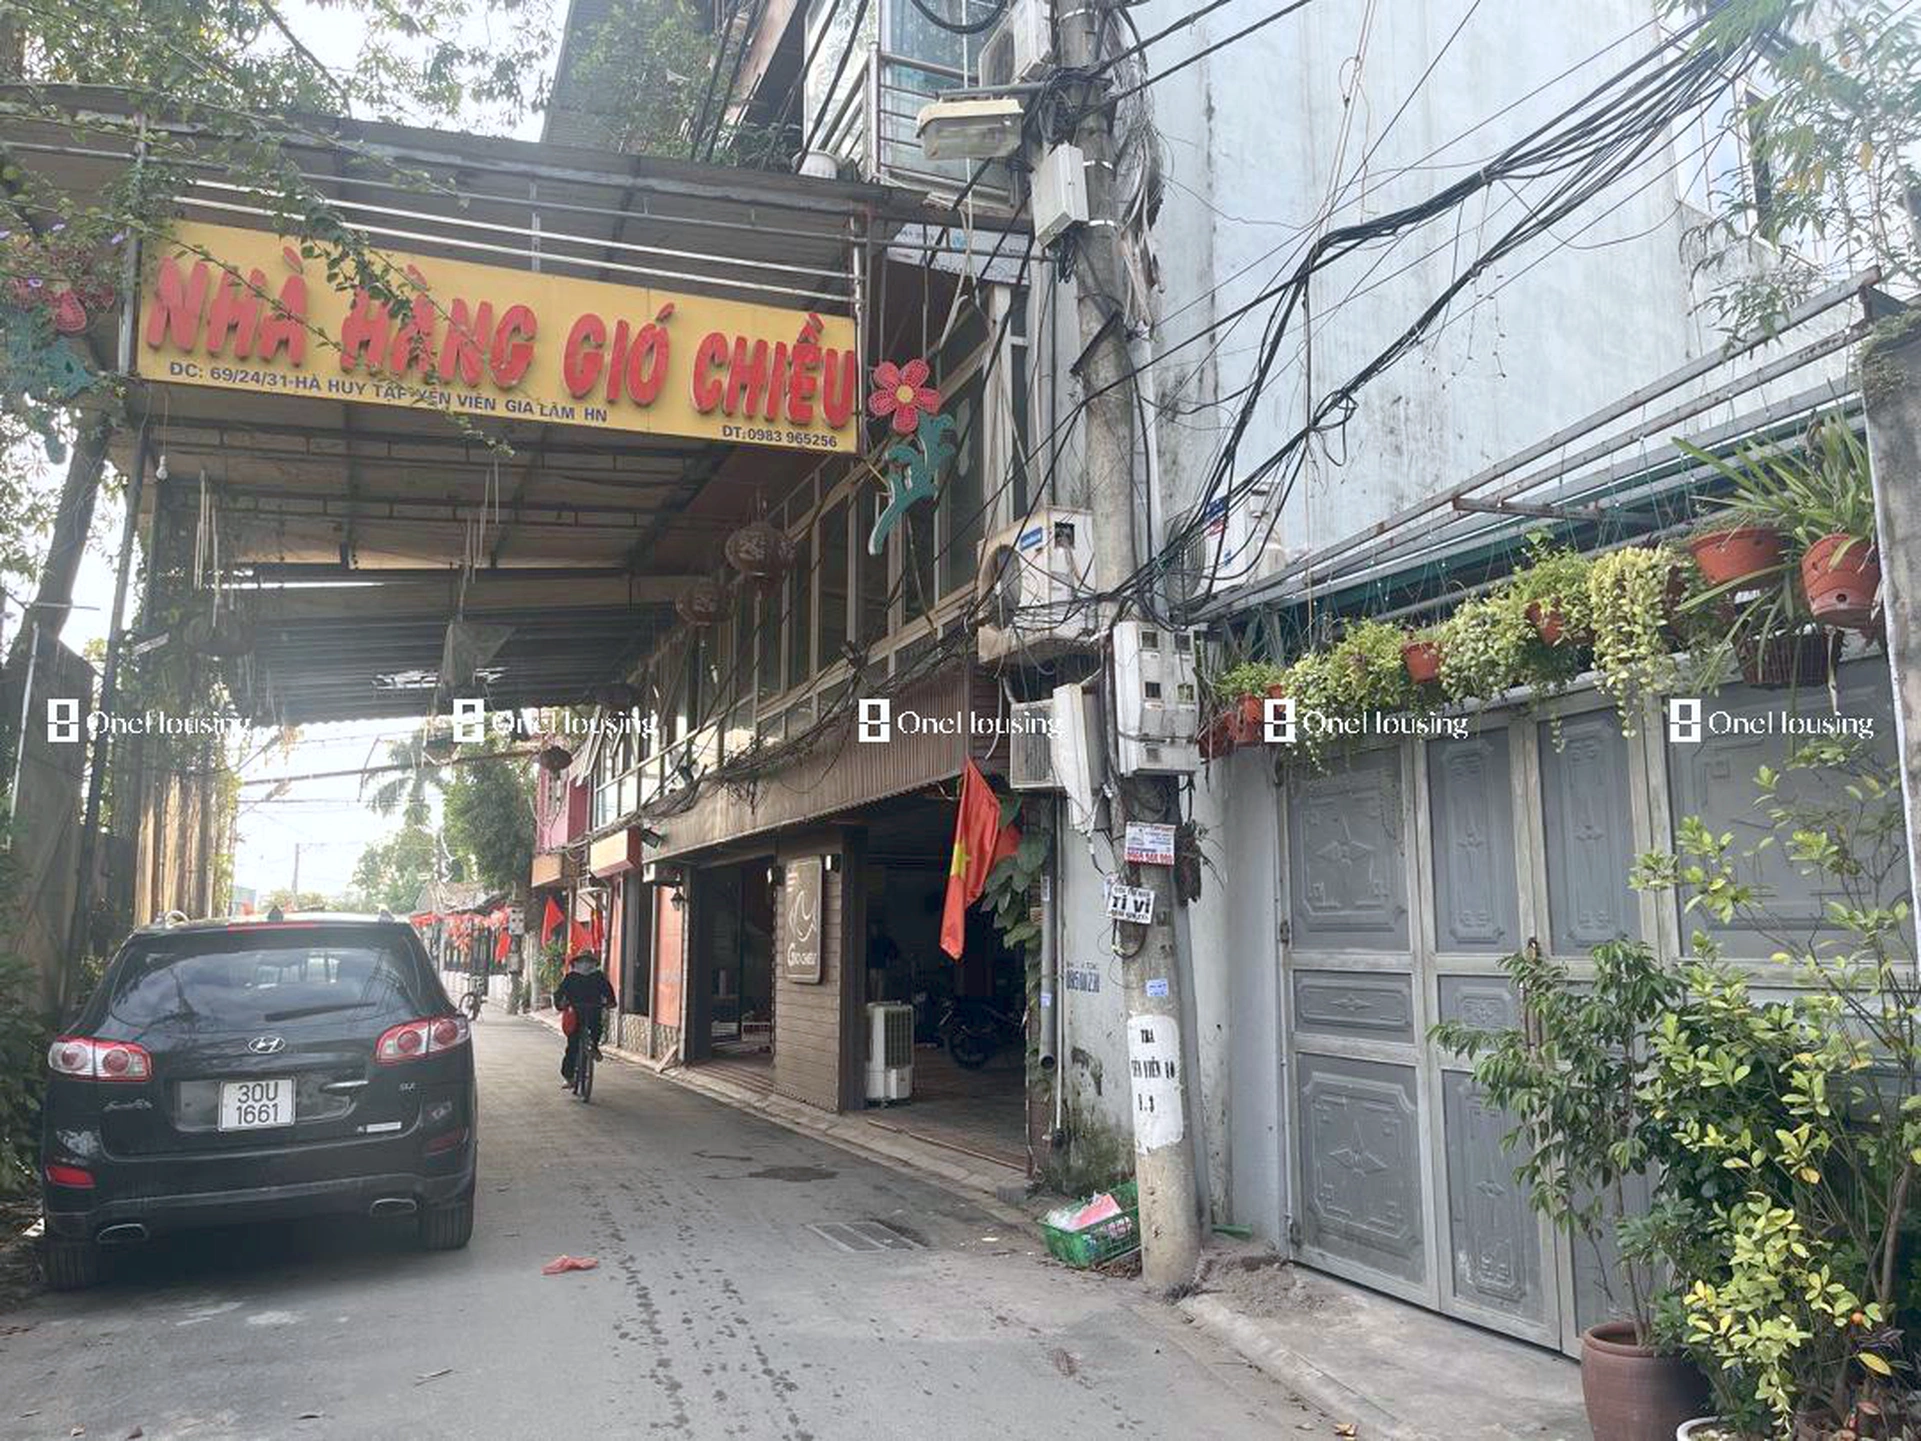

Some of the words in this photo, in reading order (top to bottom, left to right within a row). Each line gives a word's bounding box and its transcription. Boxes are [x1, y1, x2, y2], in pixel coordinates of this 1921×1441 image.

[146, 246, 308, 368] NHÀ
[340, 263, 537, 390] HÀNG
[563, 303, 674, 406] GIÓ
[693, 311, 854, 428] CHIỀU
[328, 378, 367, 396] HUY
[456, 392, 496, 411] VIÊN
[505, 399, 534, 415] GIA
[584, 406, 607, 422] HN
[786, 431, 837, 448] 965256
[237, 1082, 279, 1104] 30U
[236, 1103, 279, 1125] 1661
